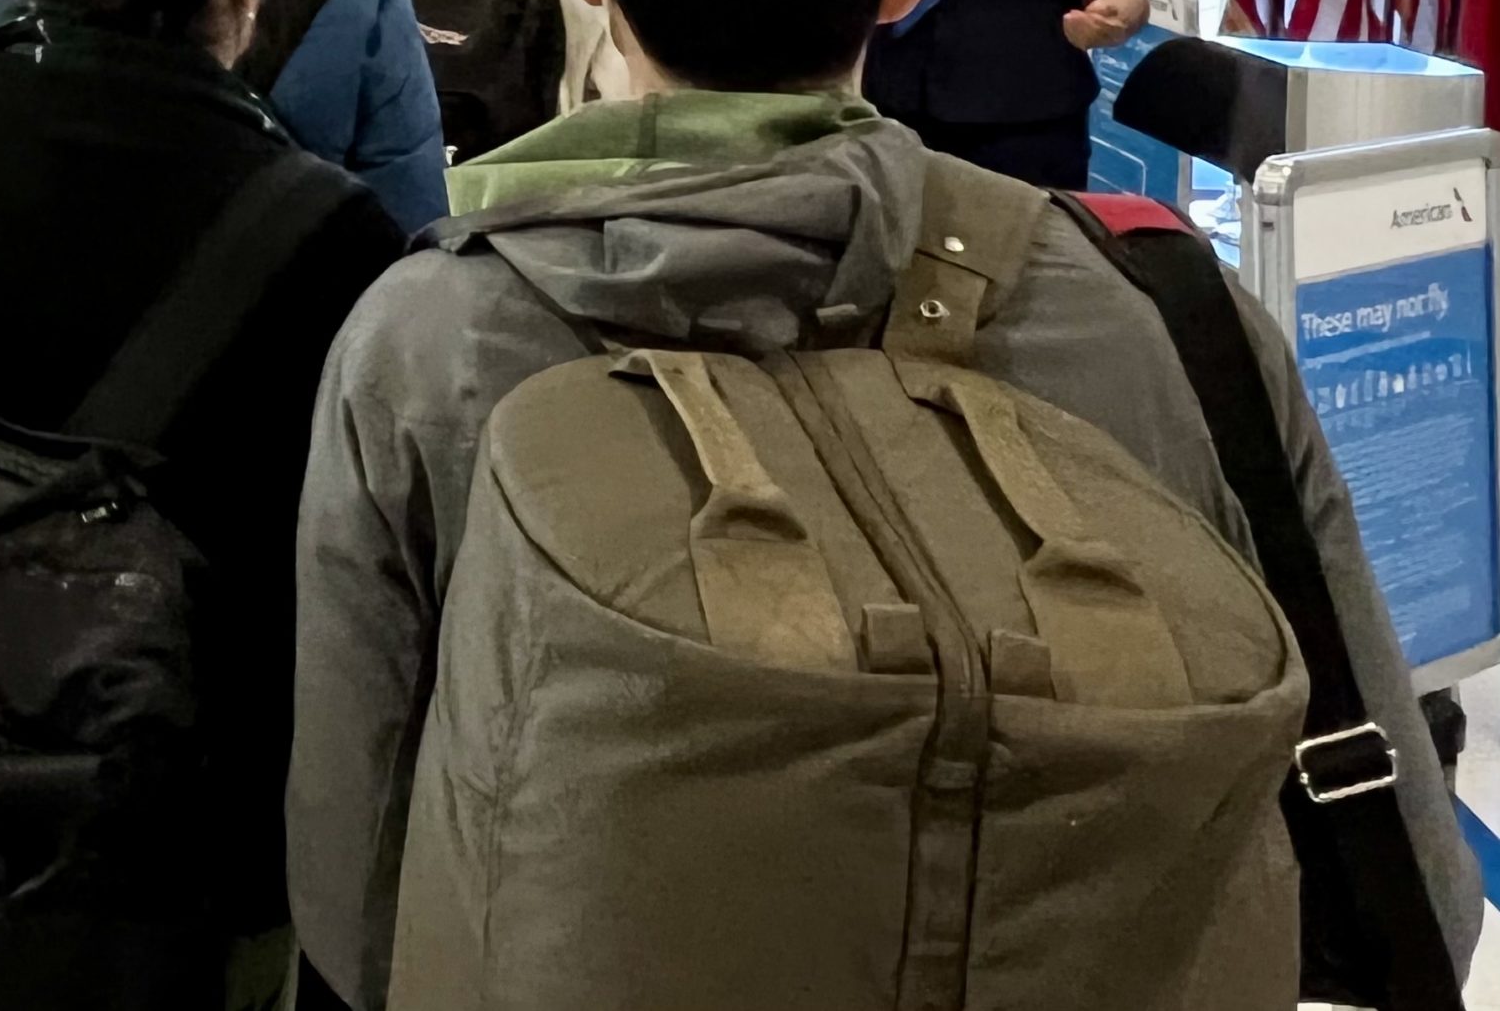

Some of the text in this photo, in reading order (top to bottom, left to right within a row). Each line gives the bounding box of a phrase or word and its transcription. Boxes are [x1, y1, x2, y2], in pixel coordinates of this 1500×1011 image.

[1390, 202, 1453, 229] American
[1301, 310, 1353, 341] These
[1356, 303, 1393, 333] may
